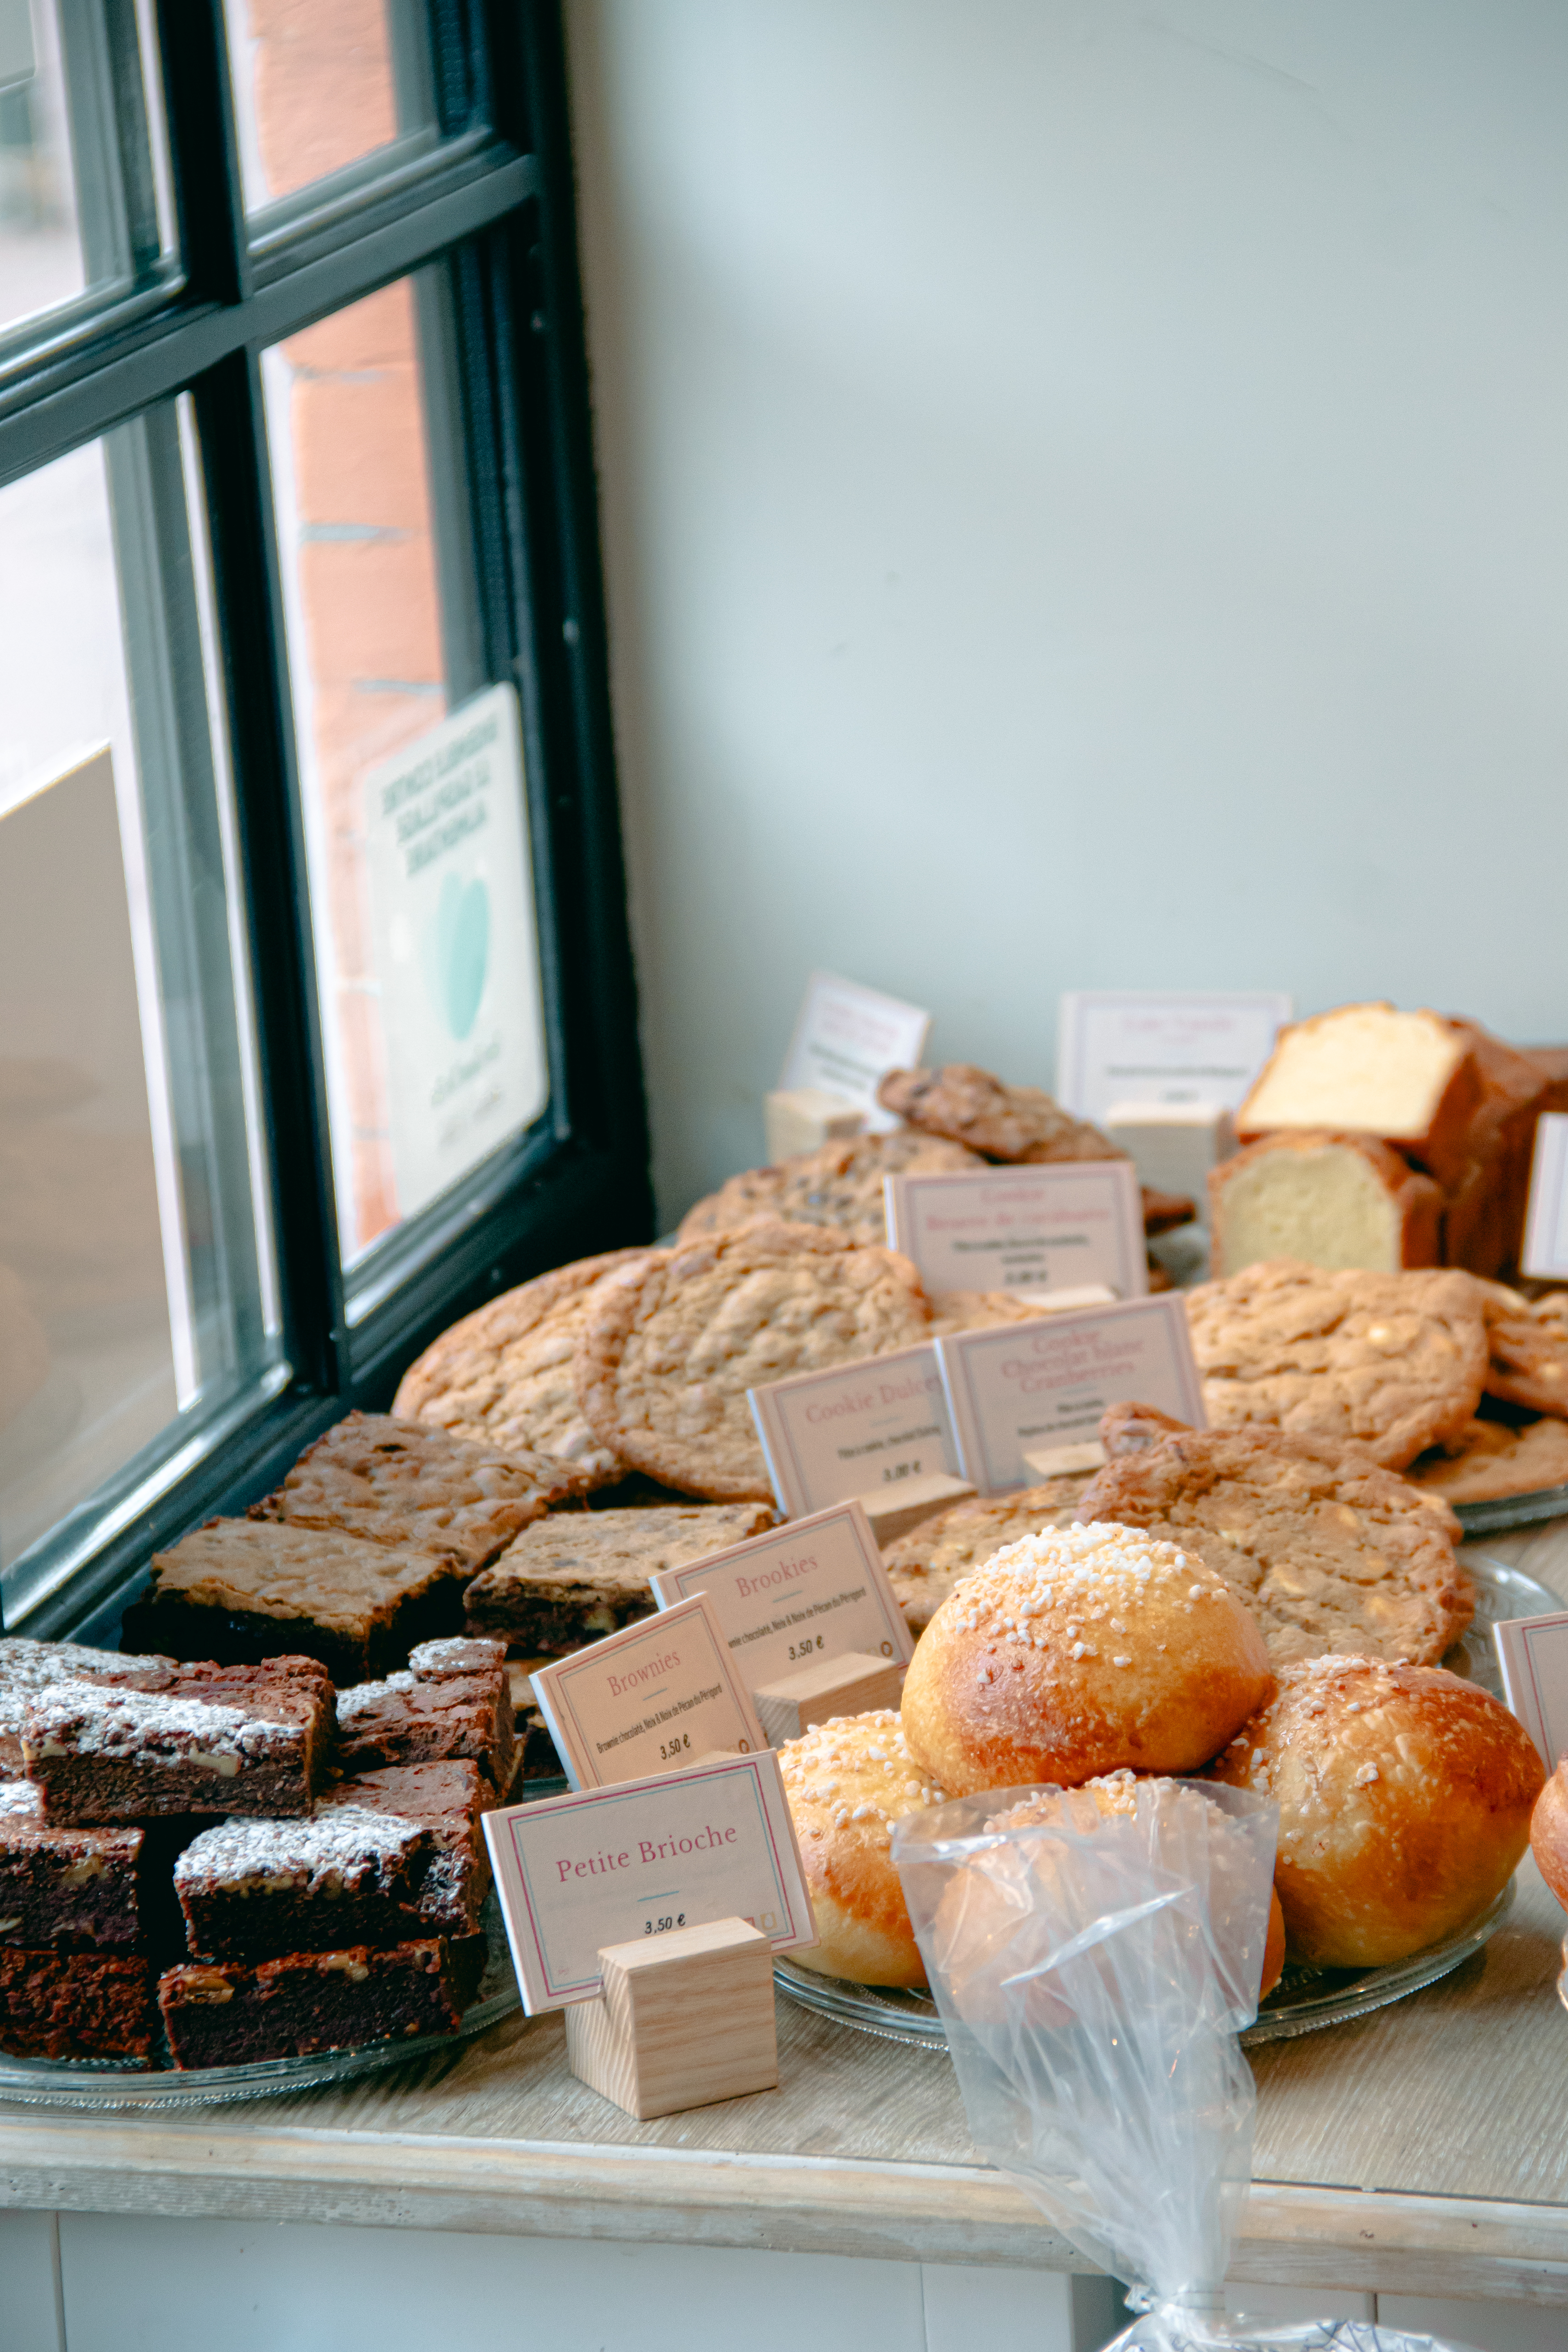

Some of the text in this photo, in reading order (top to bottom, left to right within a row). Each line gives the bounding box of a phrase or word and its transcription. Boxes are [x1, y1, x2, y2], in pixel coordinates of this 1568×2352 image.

[806, 1376, 942, 1424] Cookie Dulce
[735, 1556, 818, 1598] Brookies
[788, 1640, 813, 1660] 3,50
[607, 1651, 681, 1697] Brownies
[596, 1736, 619, 1754] Brownie
[643, 1717, 657, 1730] Noix
[654, 1713, 661, 1725] &
[659, 1709, 673, 1723] Noix
[672, 1705, 679, 1716] de
[693, 1694, 702, 1705] du
[660, 1733, 691, 1760] 3,50 €
[555, 1825, 738, 1883] Petite Brioche
[644, 1913, 686, 1935] 3,50 €
